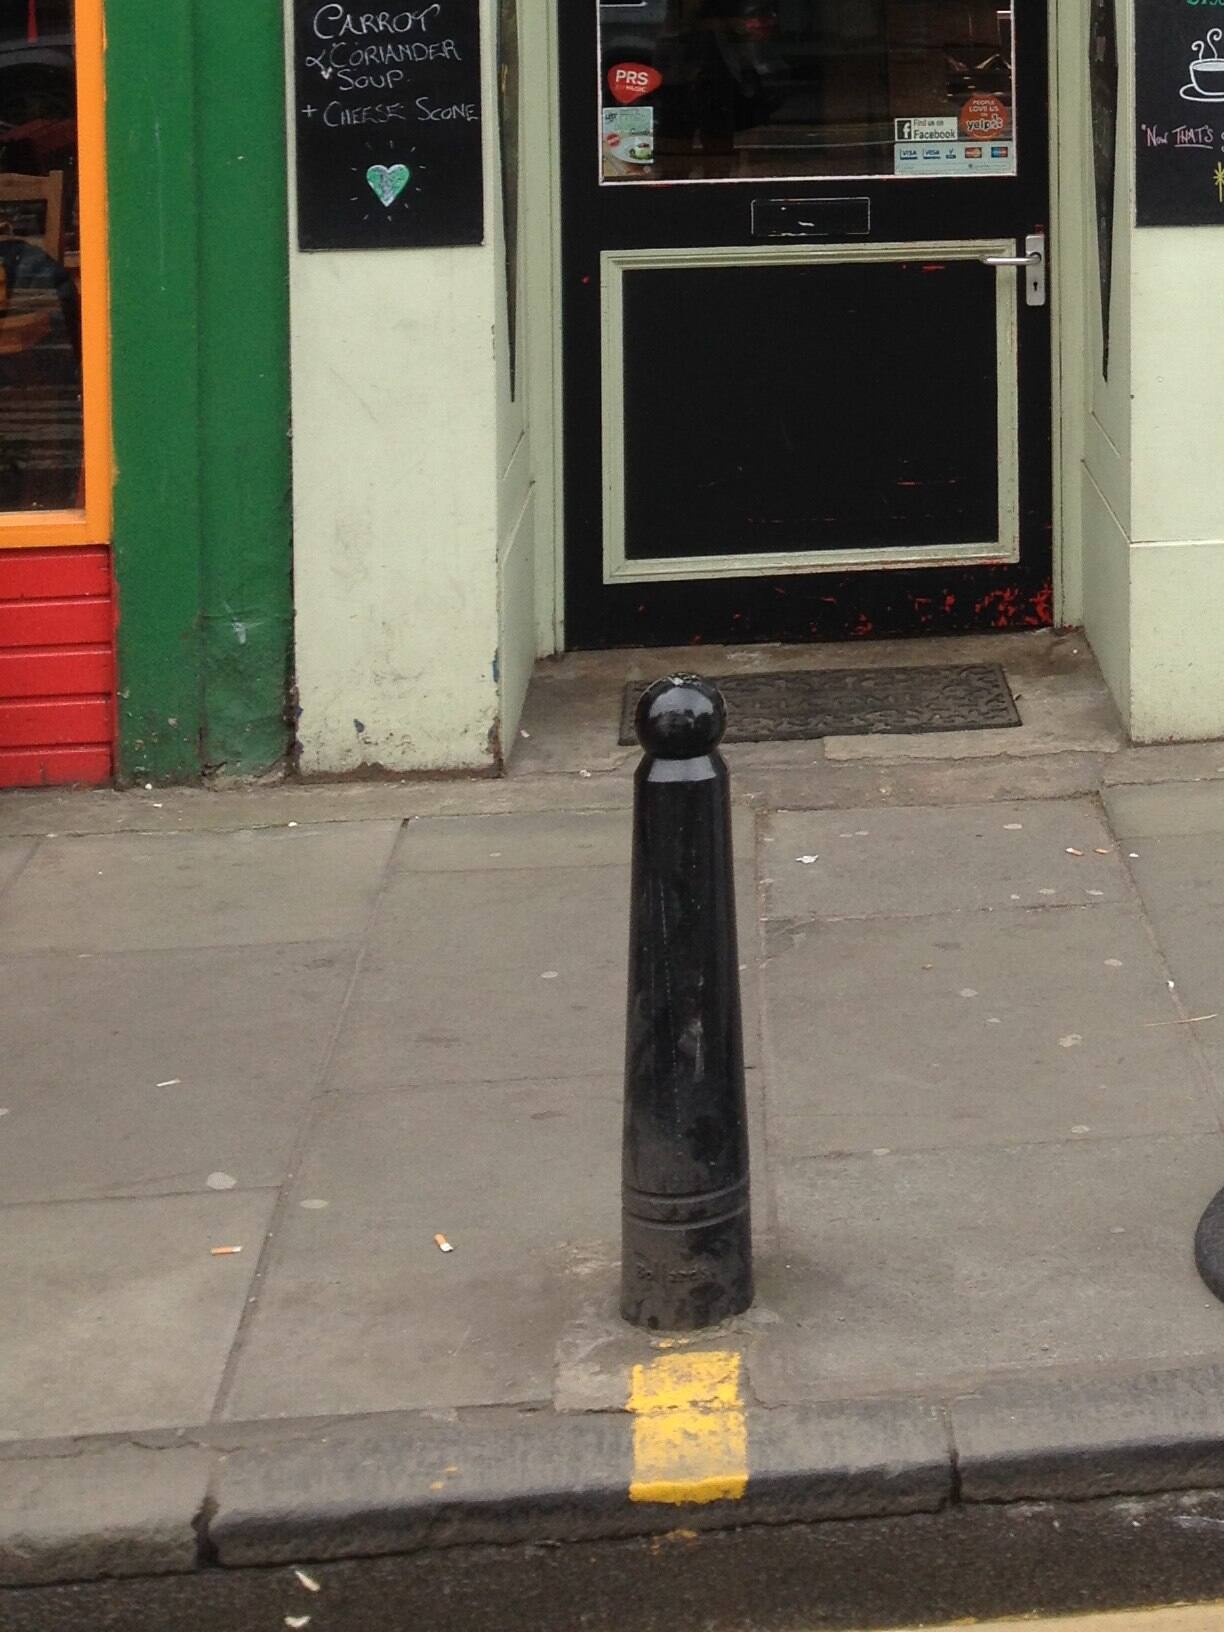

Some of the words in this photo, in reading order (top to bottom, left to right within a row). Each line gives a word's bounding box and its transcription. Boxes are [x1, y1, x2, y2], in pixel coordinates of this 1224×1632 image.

[313, 3, 441, 39] CARROT
[329, 39, 462, 68] CORIANDER
[616, 69, 649, 86] PRS
[323, 100, 406, 127] CHEESE
[415, 96, 479, 122] SCONE
[913, 129, 956, 139] Facebook
